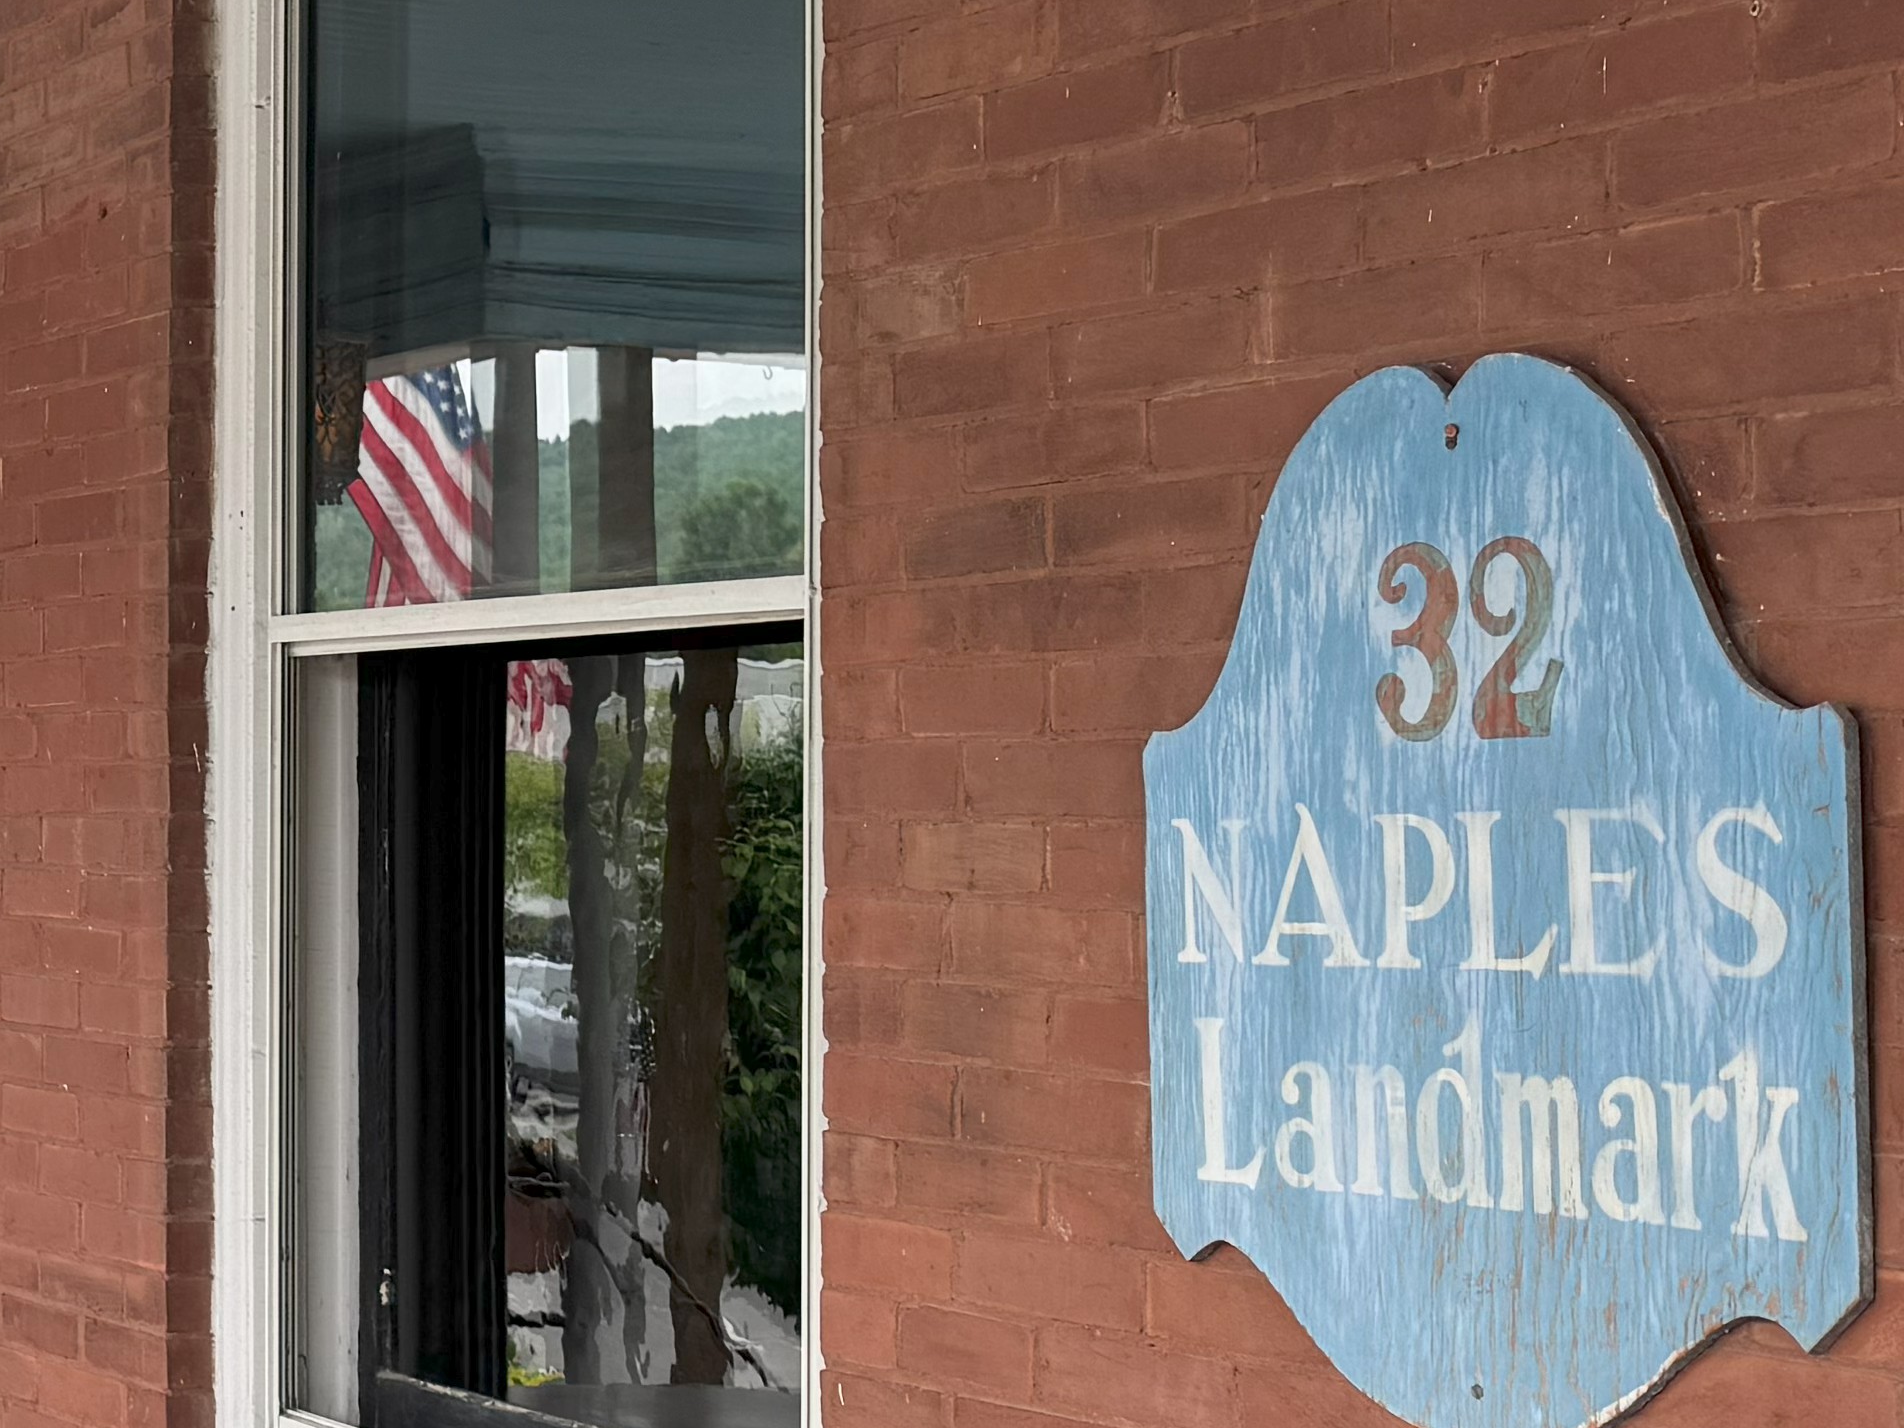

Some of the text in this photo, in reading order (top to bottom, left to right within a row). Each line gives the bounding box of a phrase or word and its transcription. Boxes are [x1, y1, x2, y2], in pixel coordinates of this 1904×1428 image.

[1374, 535, 1564, 743] 32
[1170, 801, 1790, 980] NAPLES
[1193, 1010, 1810, 1243] Landmark
